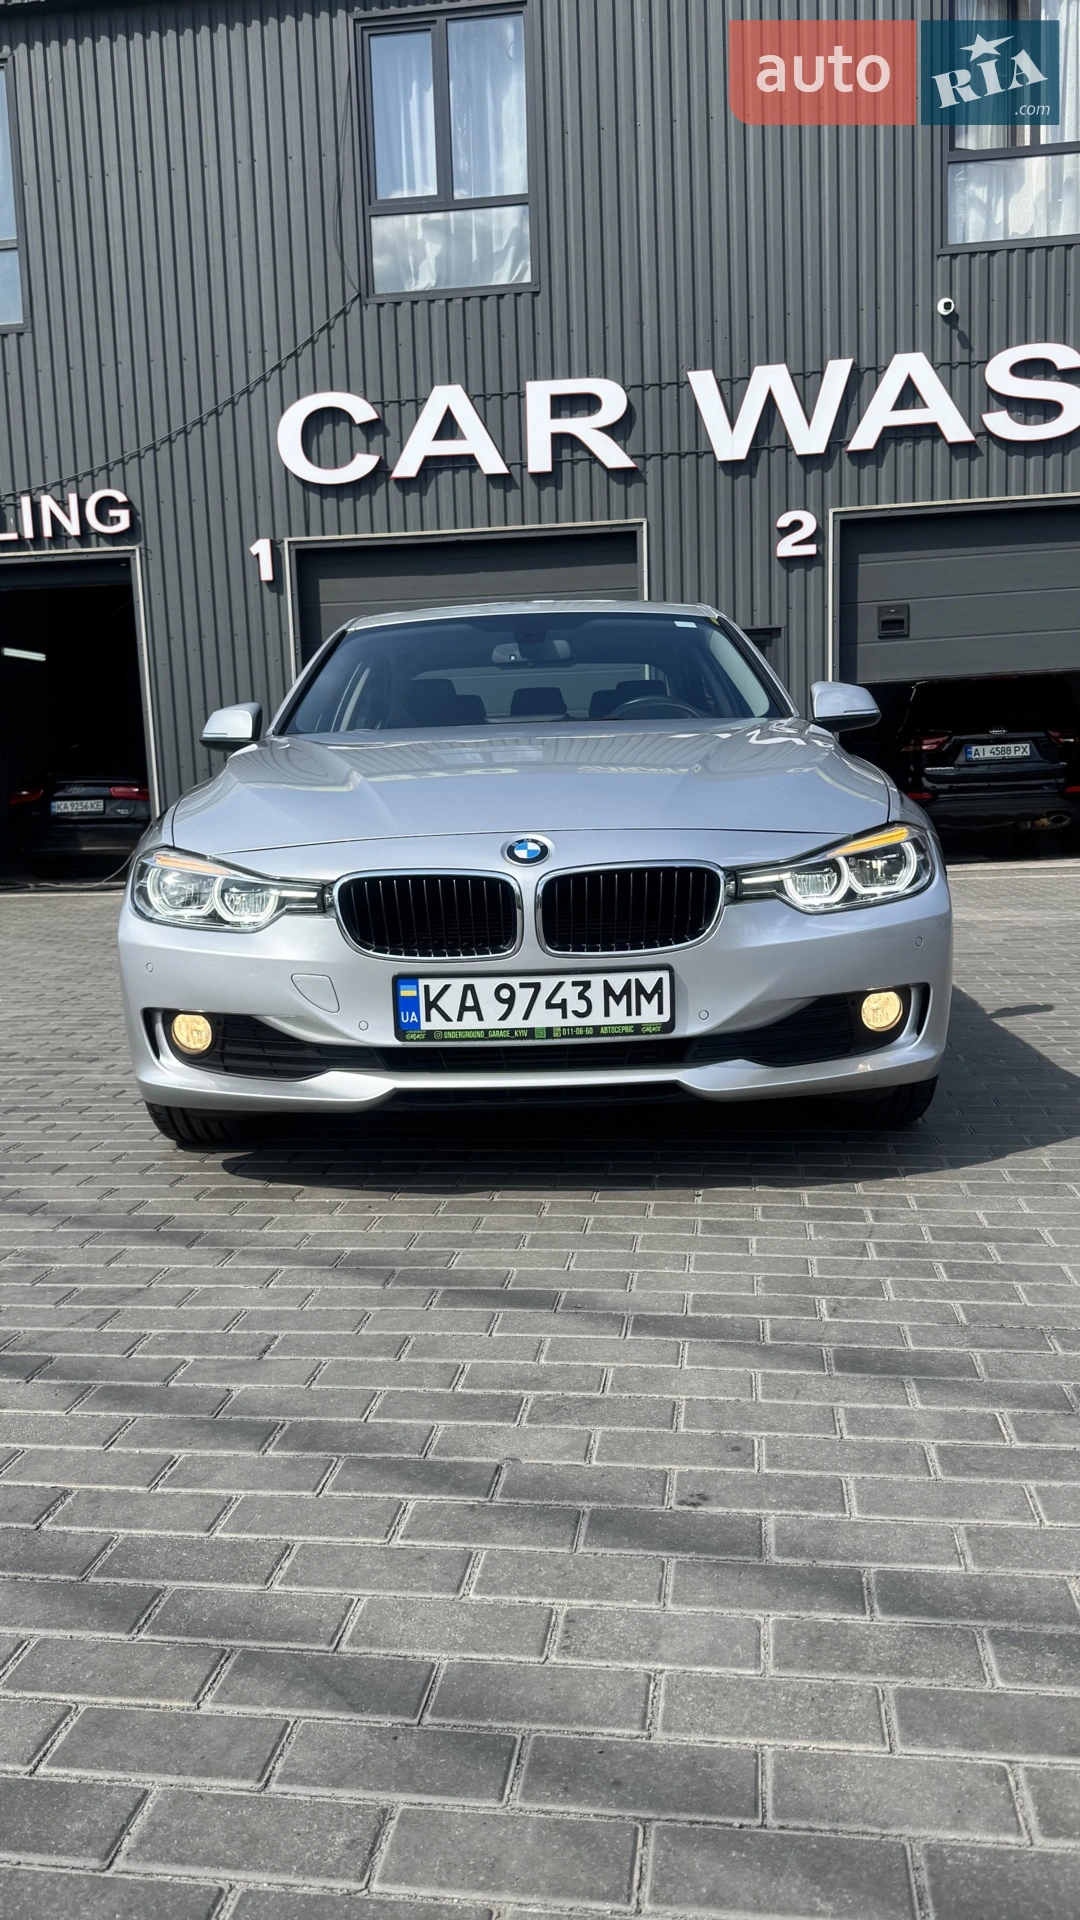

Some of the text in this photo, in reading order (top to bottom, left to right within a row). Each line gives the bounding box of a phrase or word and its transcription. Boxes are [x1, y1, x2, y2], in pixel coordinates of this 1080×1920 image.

[277, 341, 1080, 485] CAR WAS
[775, 509, 818, 558] 2
[249, 538, 274, 582] 1
[973, 745, 1029, 757] AI 4588 PX
[56, 801, 69, 811] KA
[401, 1011, 418, 1023] UA
[423, 977, 664, 1023] KA 9743 MM
